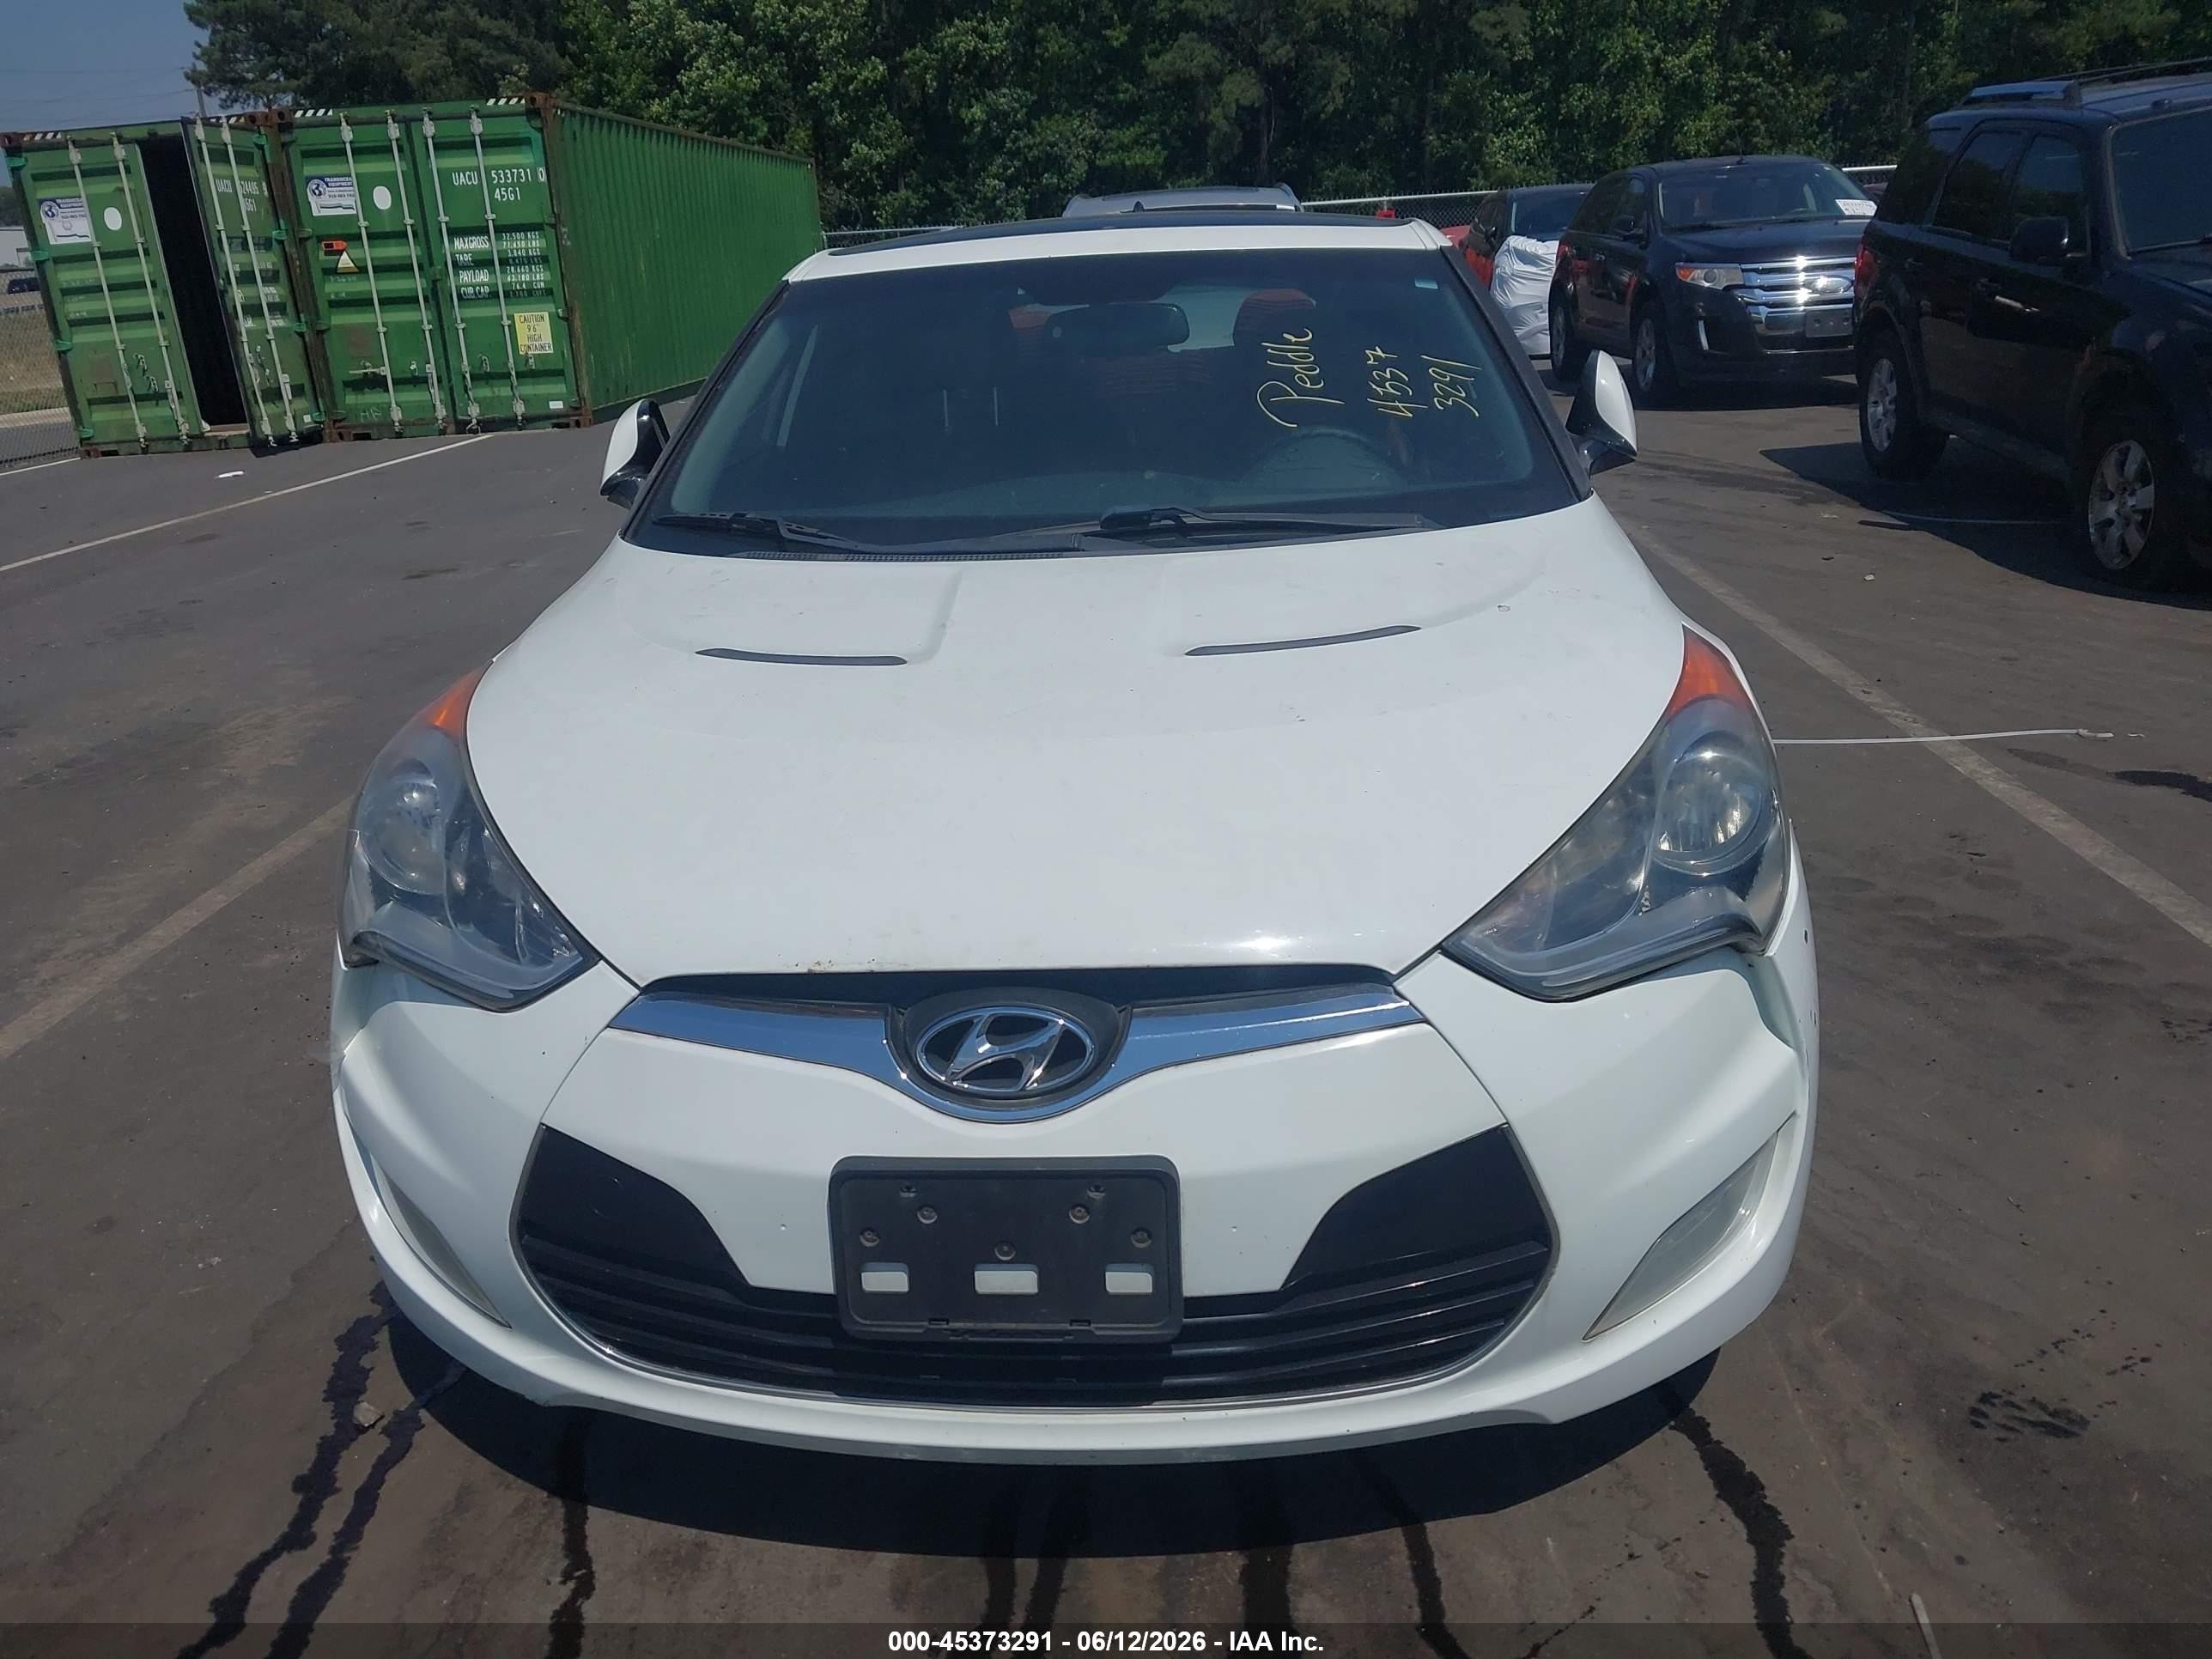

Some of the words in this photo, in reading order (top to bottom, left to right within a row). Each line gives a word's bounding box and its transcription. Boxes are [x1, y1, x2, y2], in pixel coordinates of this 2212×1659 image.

[453, 171, 478, 185] UACU
[491, 168, 532, 184] 533731
[494, 186, 521, 201] 45G1
[453, 235, 489, 250] MAXGROSS
[501, 232, 525, 240] 32.500
[455, 253, 474, 266] TARE
[459, 269, 489, 283] PAYLOAD
[519, 313, 545, 324] CAUTION
[526, 333, 543, 343] HIGH
[520, 343, 552, 353] CONTAINER
[1364, 345, 1429, 417] 4537
[1420, 354, 1482, 417] 3291
